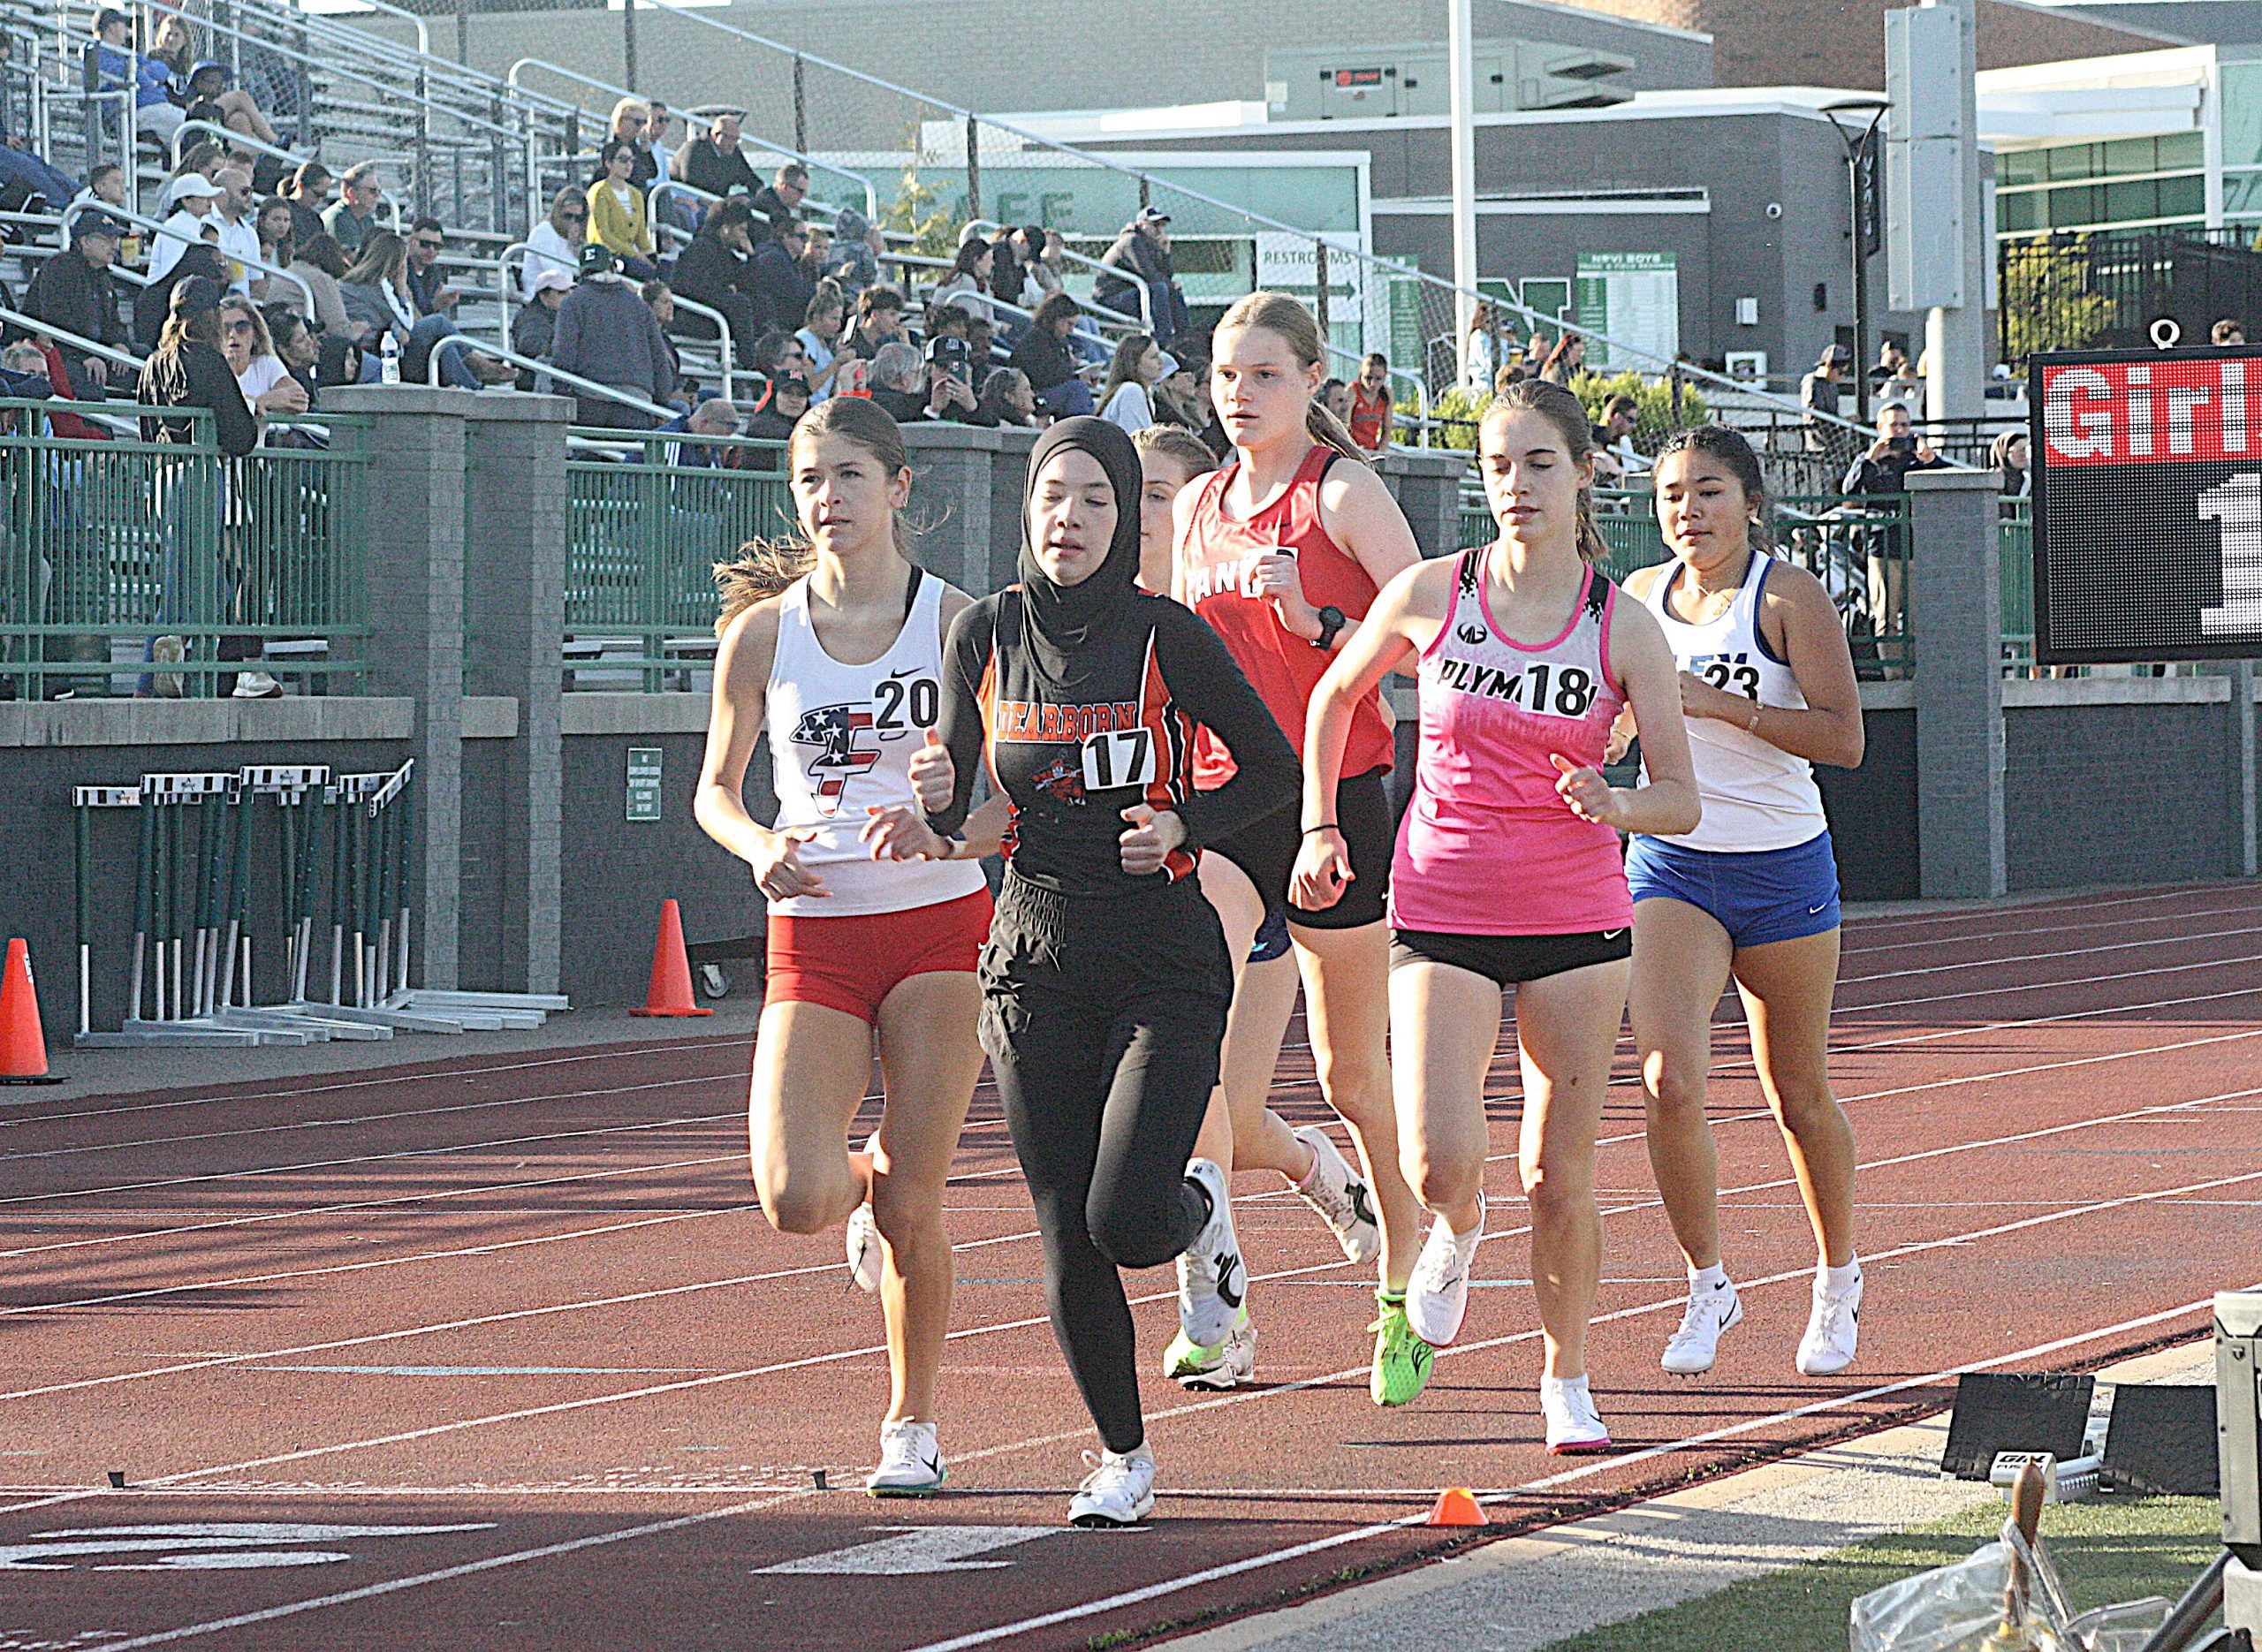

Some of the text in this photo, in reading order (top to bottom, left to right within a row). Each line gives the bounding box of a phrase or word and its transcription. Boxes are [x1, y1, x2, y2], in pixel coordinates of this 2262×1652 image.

[1264, 250, 1353, 265] RESTROMS
[2043, 362, 2262, 459] Girl
[2197, 473, 2262, 636] 1
[875, 678, 939, 729] 20
[1528, 664, 1590, 717] 18
[1704, 663, 1760, 702] 23
[996, 701, 1138, 744] DEARBORN
[1086, 731, 1149, 787] 17
